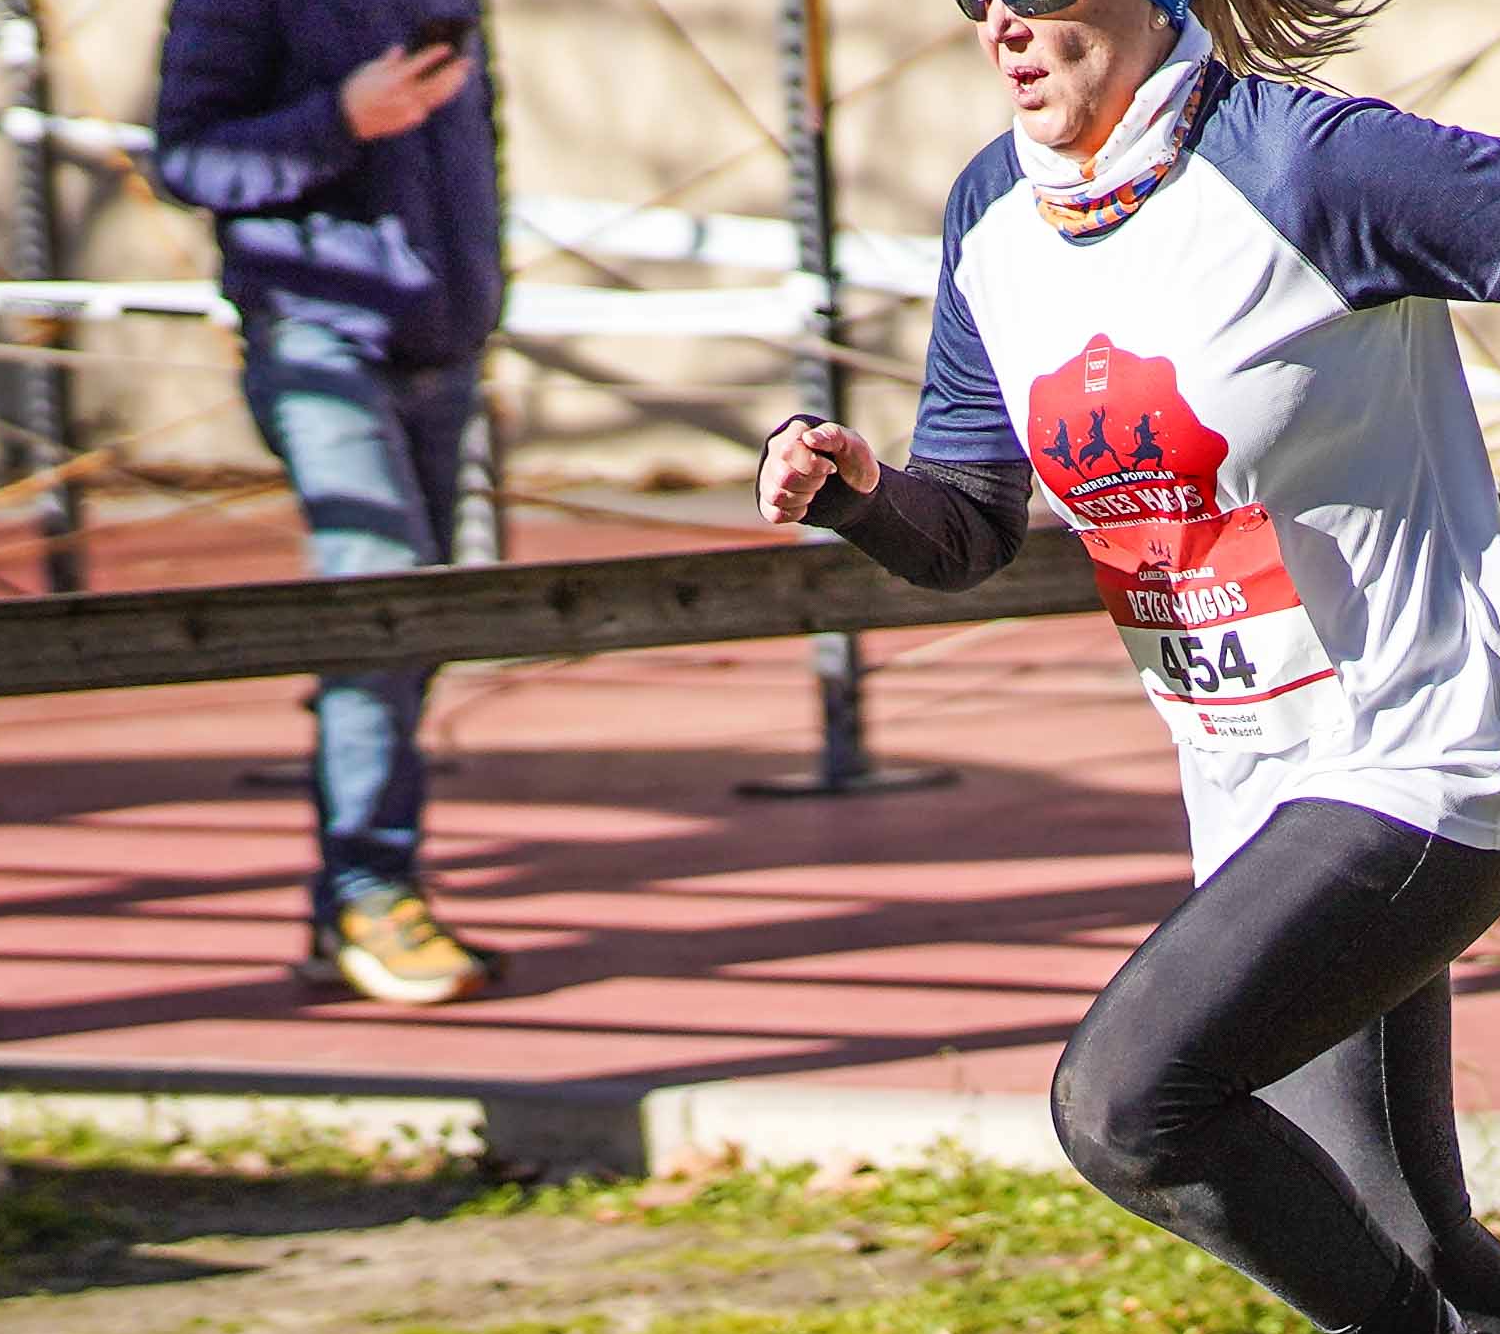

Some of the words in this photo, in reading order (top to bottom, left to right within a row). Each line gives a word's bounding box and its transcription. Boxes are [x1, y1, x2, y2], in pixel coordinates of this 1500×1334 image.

[1070, 475, 1122, 496] CARRERA
[1121, 470, 1175, 483] POPULAR
[1075, 493, 1140, 518] REYES
[1126, 590, 1173, 623] REYES
[1172, 582, 1248, 624] MAGOS
[1160, 631, 1257, 692] 454
